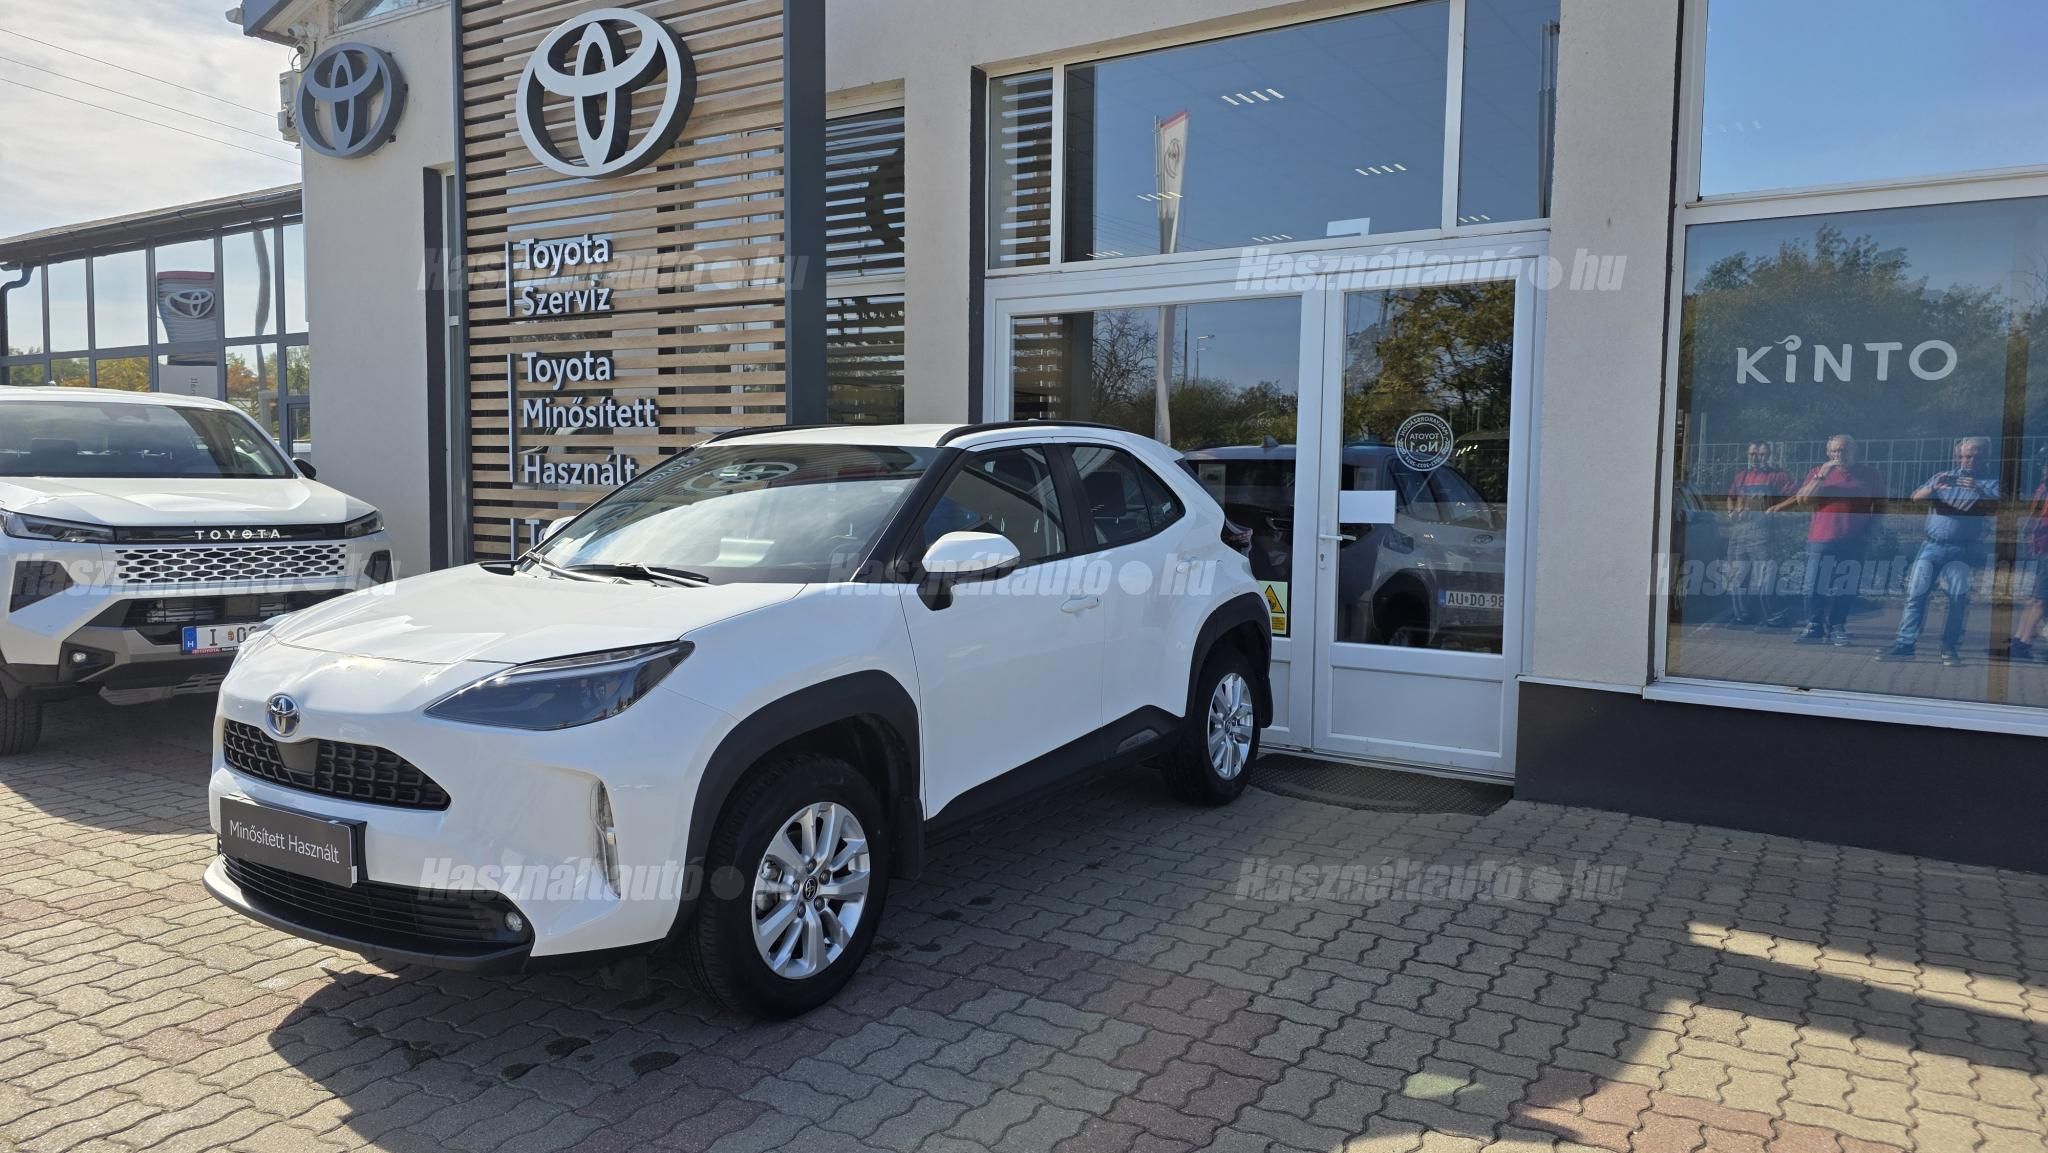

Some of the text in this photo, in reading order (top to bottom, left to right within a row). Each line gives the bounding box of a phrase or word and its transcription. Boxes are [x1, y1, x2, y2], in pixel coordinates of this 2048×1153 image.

[520, 234, 610, 277] Toyota
[522, 280, 611, 316] Szerviz
[522, 351, 611, 390] Toyota
[523, 397, 656, 428] Minősített
[524, 454, 635, 486] Használt
[195, 529, 280, 540] TOYOTA
[229, 819, 340, 864] Minősített Használt
